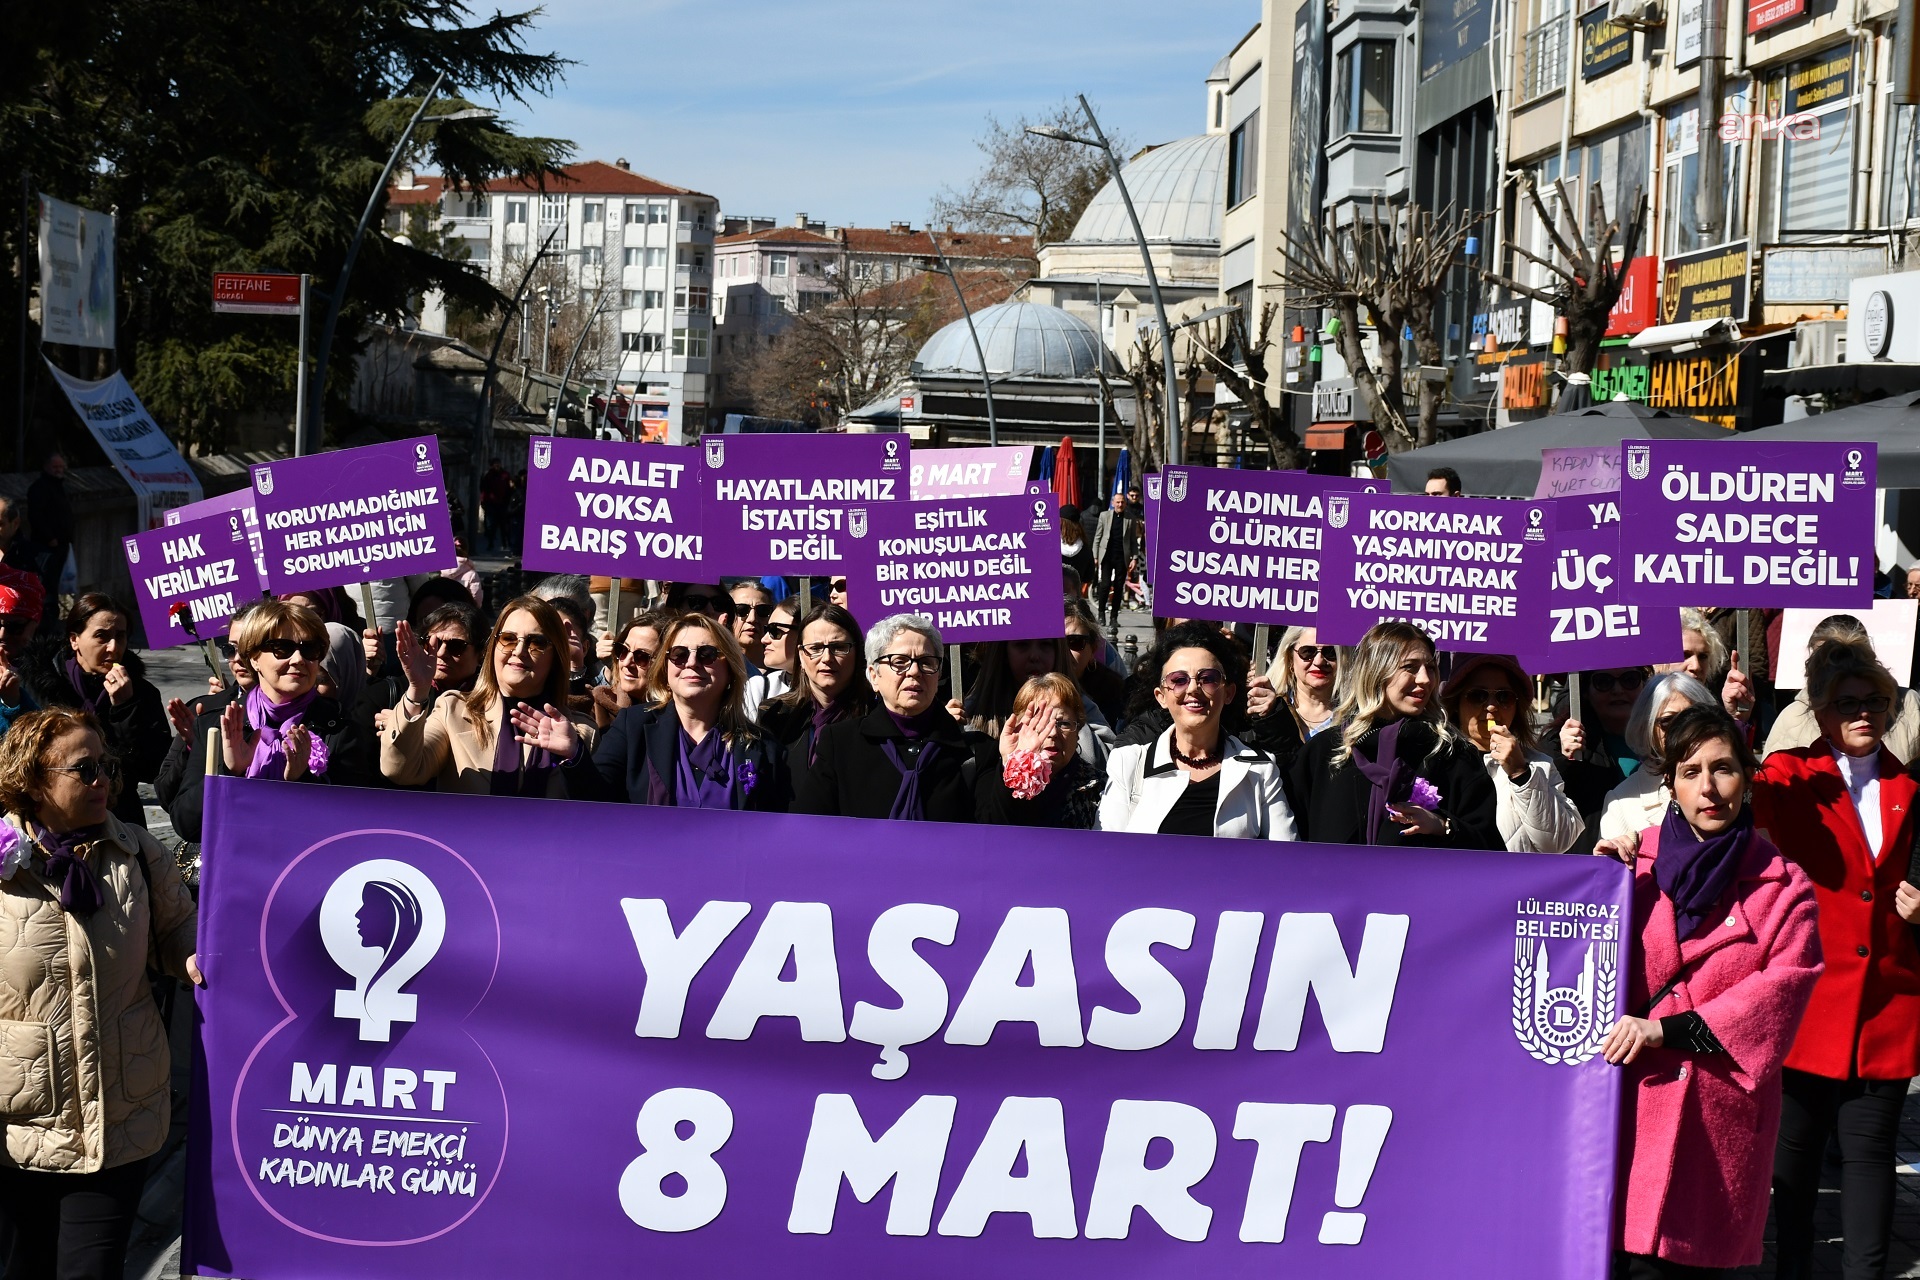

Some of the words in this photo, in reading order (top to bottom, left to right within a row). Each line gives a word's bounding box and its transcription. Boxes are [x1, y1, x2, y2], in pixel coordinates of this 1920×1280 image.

[218, 279, 271, 291] FETFANE
[1650, 352, 1740, 408] HANEDAN
[567, 456, 685, 489] ADALET
[910, 464, 925, 487] 8
[928, 462, 997, 487] MART
[1602, 454, 1621, 471] KA
[716, 478, 896, 501] HAYATLARIMIZ
[1548, 478, 1587, 498] YURT
[1661, 464, 1835, 503] ÖLDÜREN
[265, 486, 439, 535] KORUYAMADIĞINIZ
[574, 491, 674, 524] YOKSA
[742, 504, 844, 531] İSTATİST
[914, 506, 988, 532] EŞİTLİK
[1206, 488, 1324, 524] KADINLA
[1369, 509, 1503, 536] KORKARAK
[1588, 502, 1621, 525] YA
[285, 530, 325, 552] HER
[324, 519, 385, 545] KADIN
[386, 511, 427, 537] İÇİN
[540, 524, 628, 560] BARIŞ
[633, 530, 703, 561] YOK!
[878, 531, 1027, 558] KONUŞULACAK
[1674, 512, 1819, 545] SADECE
[161, 533, 206, 565] HAK
[283, 535, 437, 576] SORUMLUSUNUZ
[770, 533, 843, 561] DEĞİL
[1351, 534, 1524, 564] YAŞAMIYORUZ
[144, 558, 240, 600] VERİLMEZ
[876, 560, 910, 582] BİR
[913, 560, 970, 580] KONU
[973, 553, 1032, 577] DEĞİL
[1169, 549, 1260, 578] SUSAN
[1266, 556, 1320, 582] HER
[1354, 561, 1518, 590] KORKUTARAK
[1634, 547, 1735, 585] KATİL
[1743, 548, 1859, 586] DEĞİL!
[169, 591, 237, 628] AINIR!
[880, 581, 1030, 607] UYGULANACAK
[1174, 581, 1319, 613] SORUMLUD
[1346, 584, 1518, 617] YÖNETENLERE
[938, 608, 1011, 628] HAKTIR
[1550, 605, 1641, 643] ZDE!
[1517, 898, 1619, 918] LÜLEBURGAZ
[1516, 919, 1619, 940] BELEDİYESİ
[619, 897, 1410, 1080] YAŞASIN
[289, 1061, 457, 1111] MART
[273, 1116, 365, 1157] DÜNYA
[370, 1126, 470, 1169] EMEKÇİ
[259, 1157, 396, 1195] KADINLAR
[401, 1158, 477, 1198] GÜNÜ
[618, 1087, 734, 1233] 8
[787, 1092, 1393, 1245] MART!
